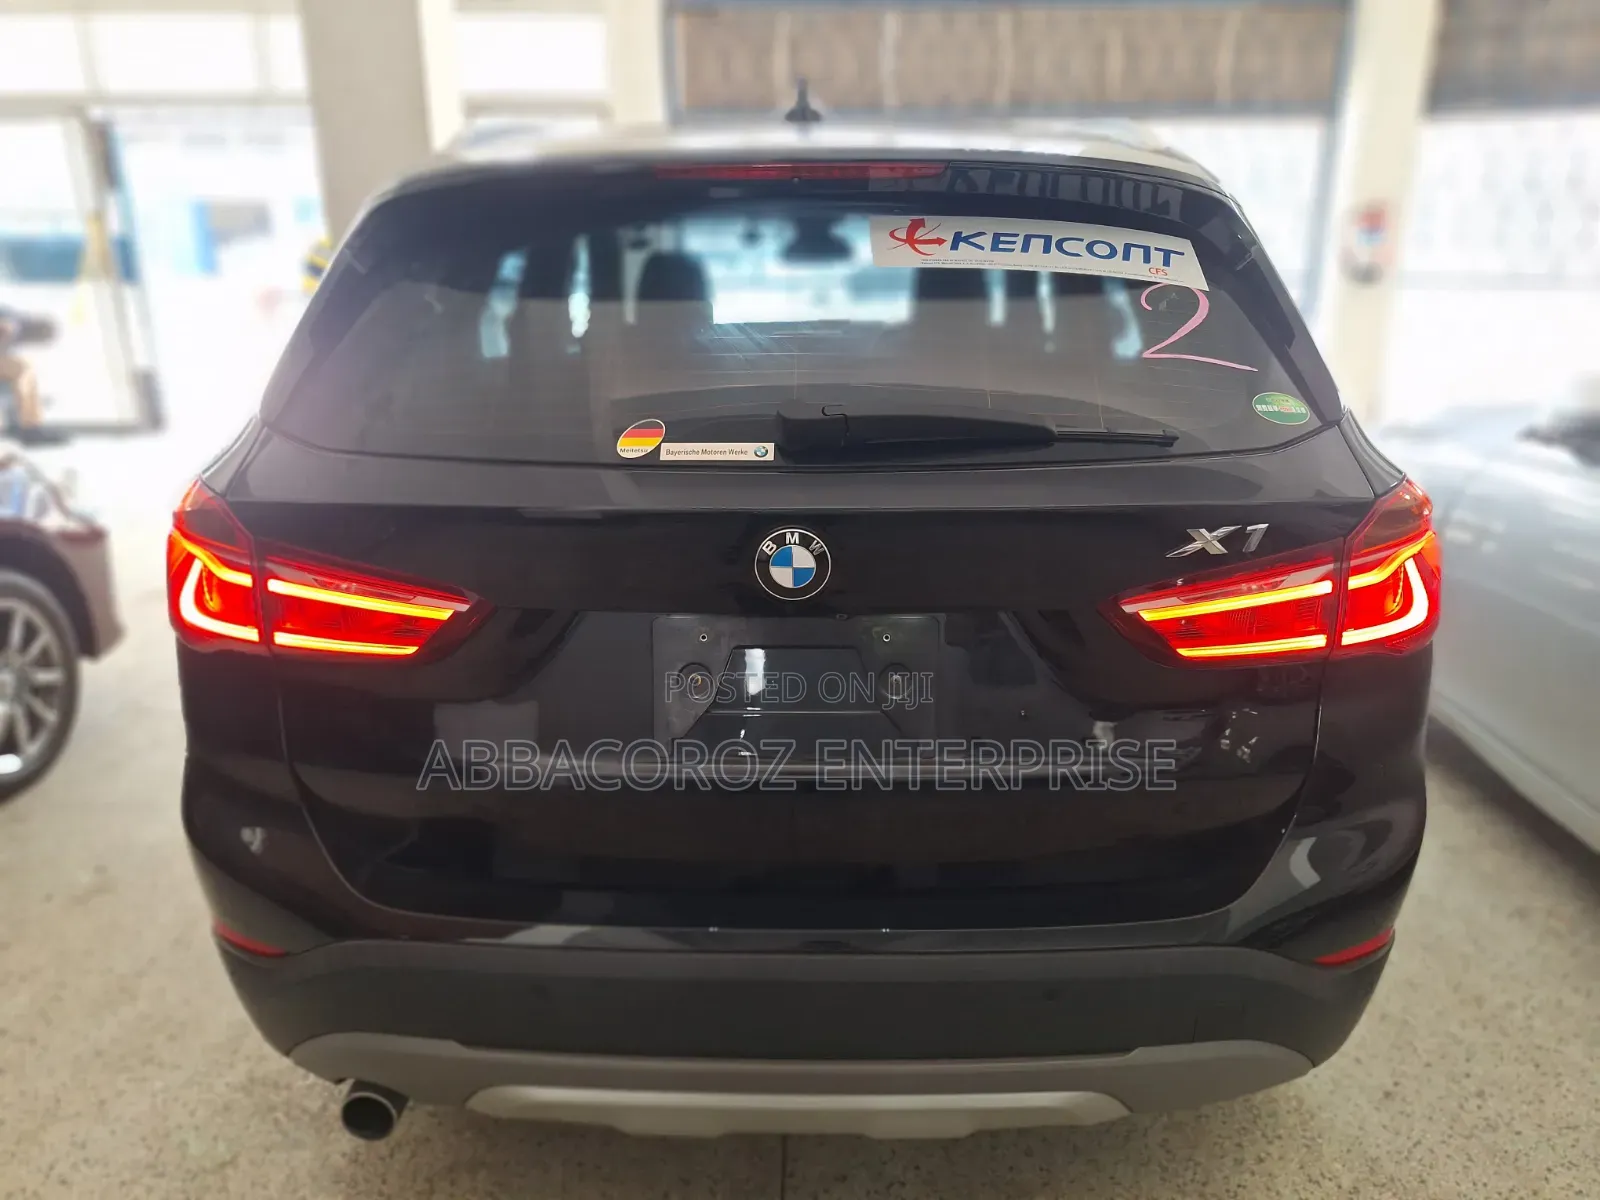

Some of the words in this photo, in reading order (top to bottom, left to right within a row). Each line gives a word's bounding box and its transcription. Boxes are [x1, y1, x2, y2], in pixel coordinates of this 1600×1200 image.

[1148, 266, 1168, 277] CFS
[1141, 282, 1259, 372] 2
[665, 448, 700, 457] Bayerische
[700, 448, 727, 456] Motoren
[728, 448, 748, 456] Werke
[761, 531, 825, 556] BMW
[1165, 523, 1269, 557] X1
